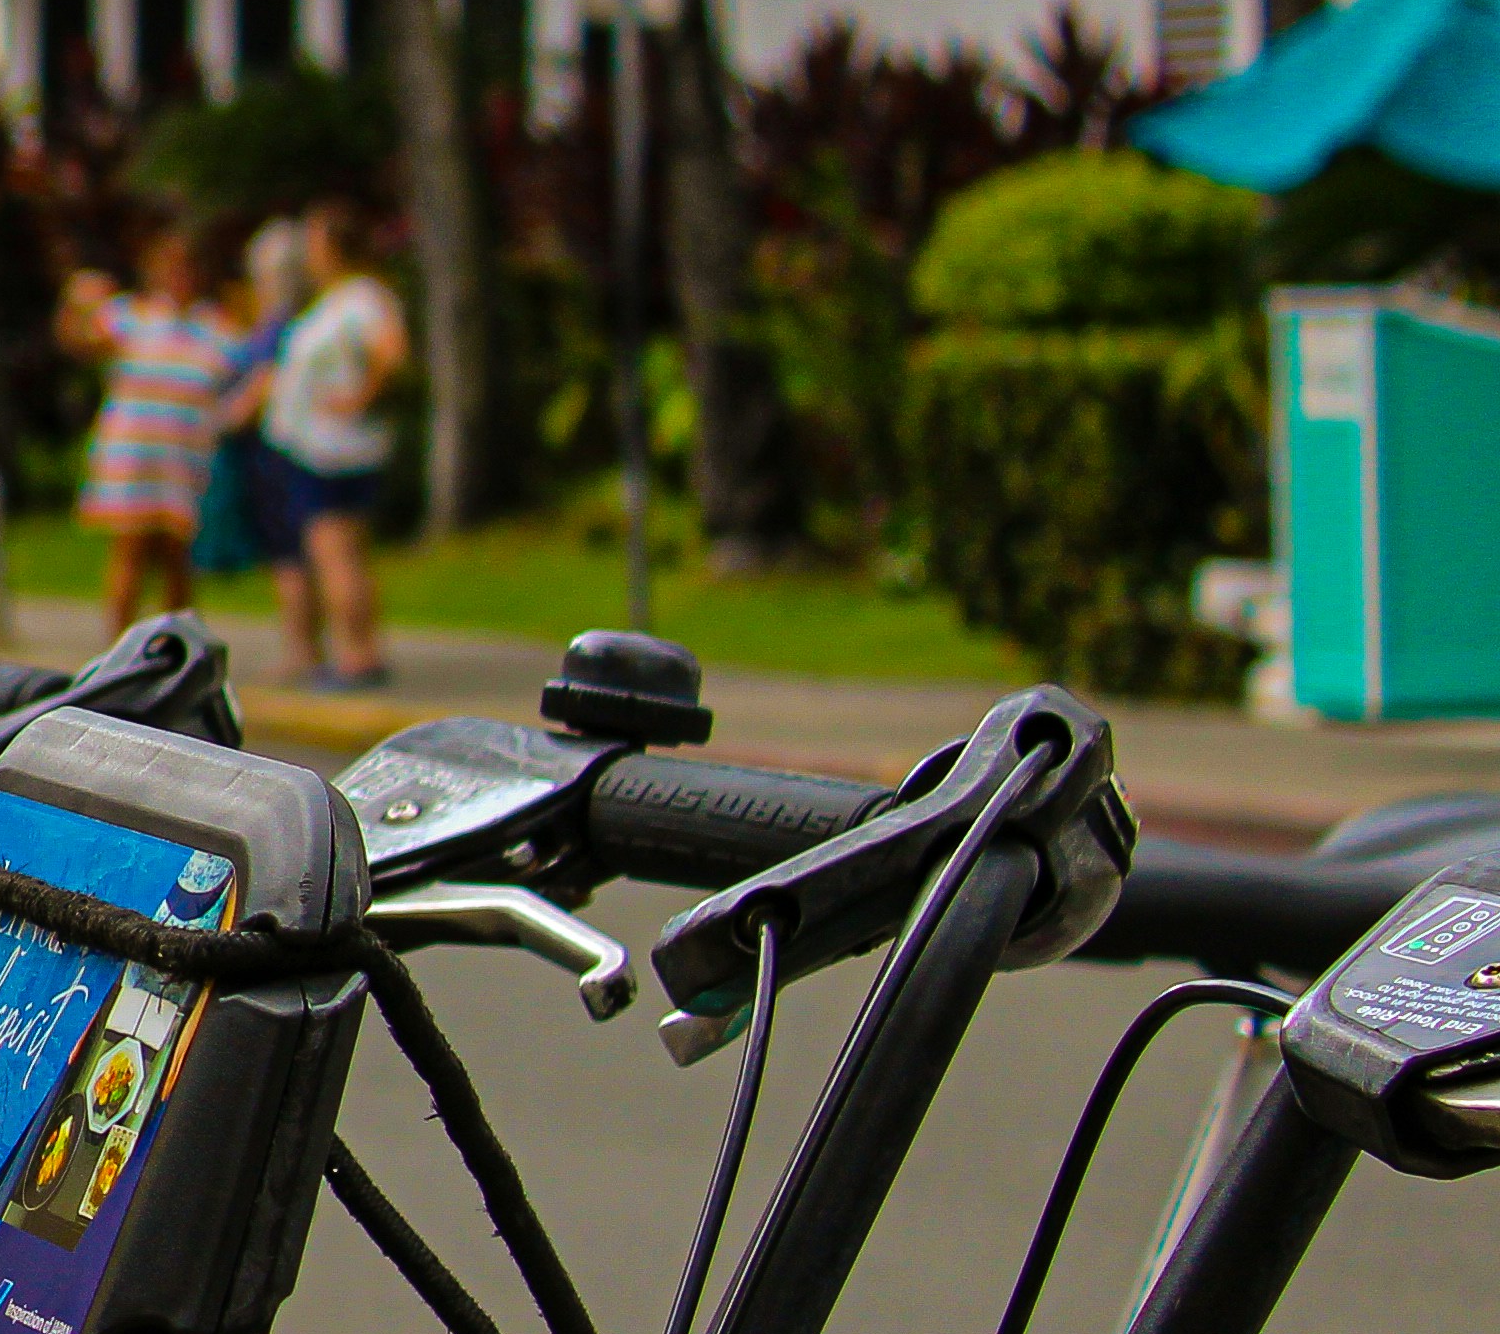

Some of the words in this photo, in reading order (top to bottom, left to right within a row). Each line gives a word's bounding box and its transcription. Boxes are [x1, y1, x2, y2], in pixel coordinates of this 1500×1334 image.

[1356, 1005, 1401, 1022] Ride
[1397, 1012, 1442, 1029] Your
[1466, 1010, 1500, 1024] ecure
[1438, 1019, 1484, 1035] End
